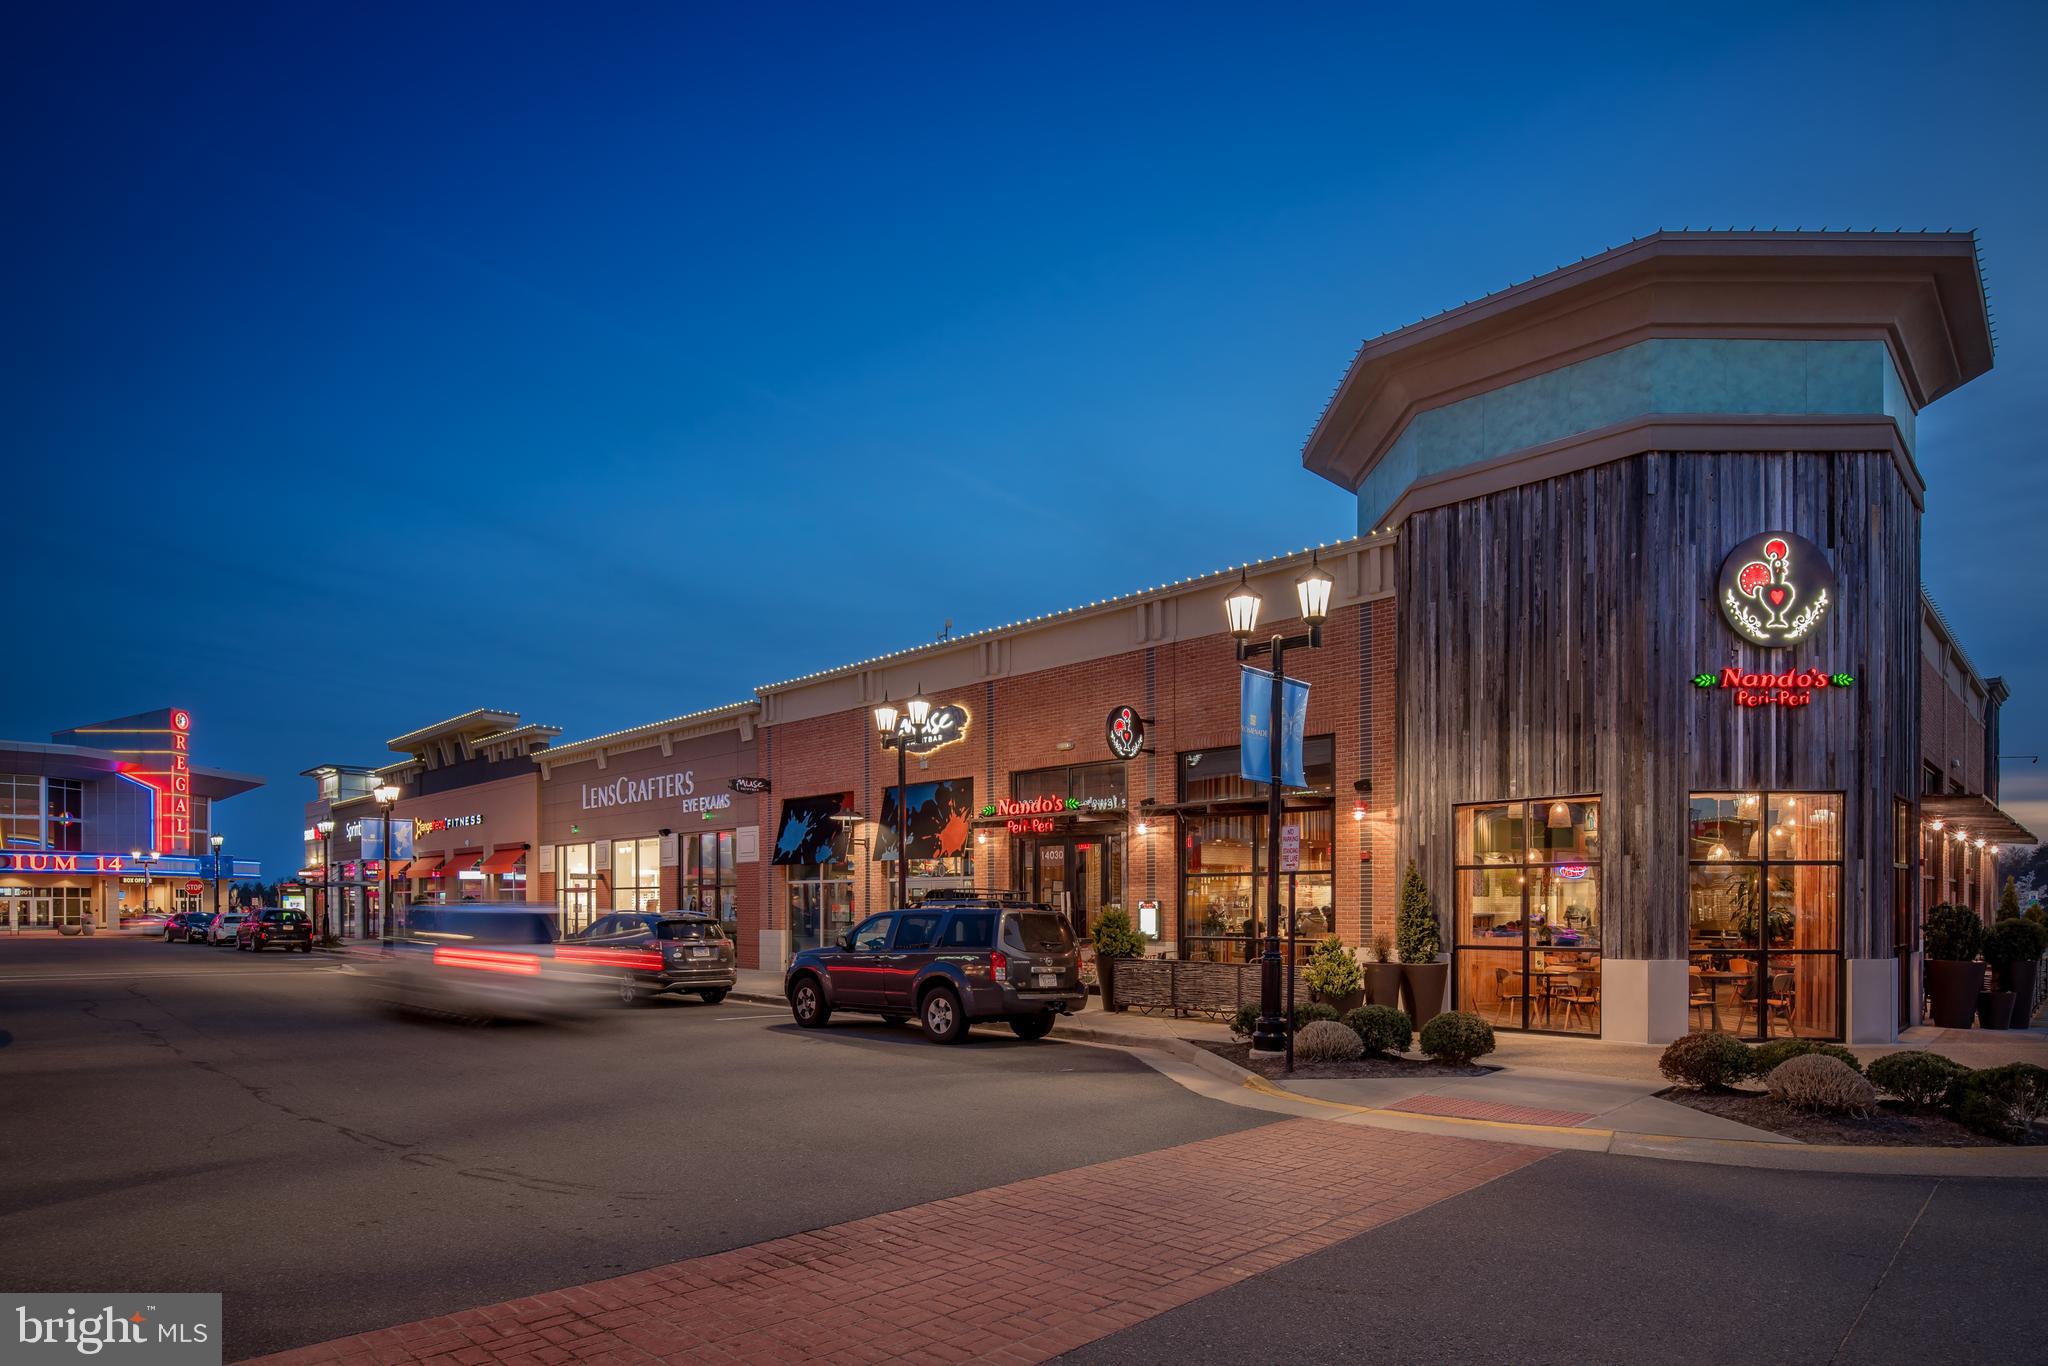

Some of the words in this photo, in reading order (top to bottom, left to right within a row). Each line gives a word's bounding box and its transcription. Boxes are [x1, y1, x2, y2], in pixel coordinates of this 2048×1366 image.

[1722, 667, 1829, 688] Nando's
[1738, 690, 1811, 706] Peri-Peri
[175, 734, 186, 833] REGAL
[582, 770, 695, 810] LENSCRAFTERS
[683, 798, 698, 813] EYE
[700, 793, 731, 812] EXAMS
[998, 794, 1063, 816] Nando's
[447, 815, 482, 829] FITNESS
[1007, 817, 1054, 833] Peri-Peri
[346, 821, 361, 842] Sprint
[97, 855, 122, 871] 14
[1041, 850, 1064, 860] 14030
[186, 883, 203, 891] STOP
